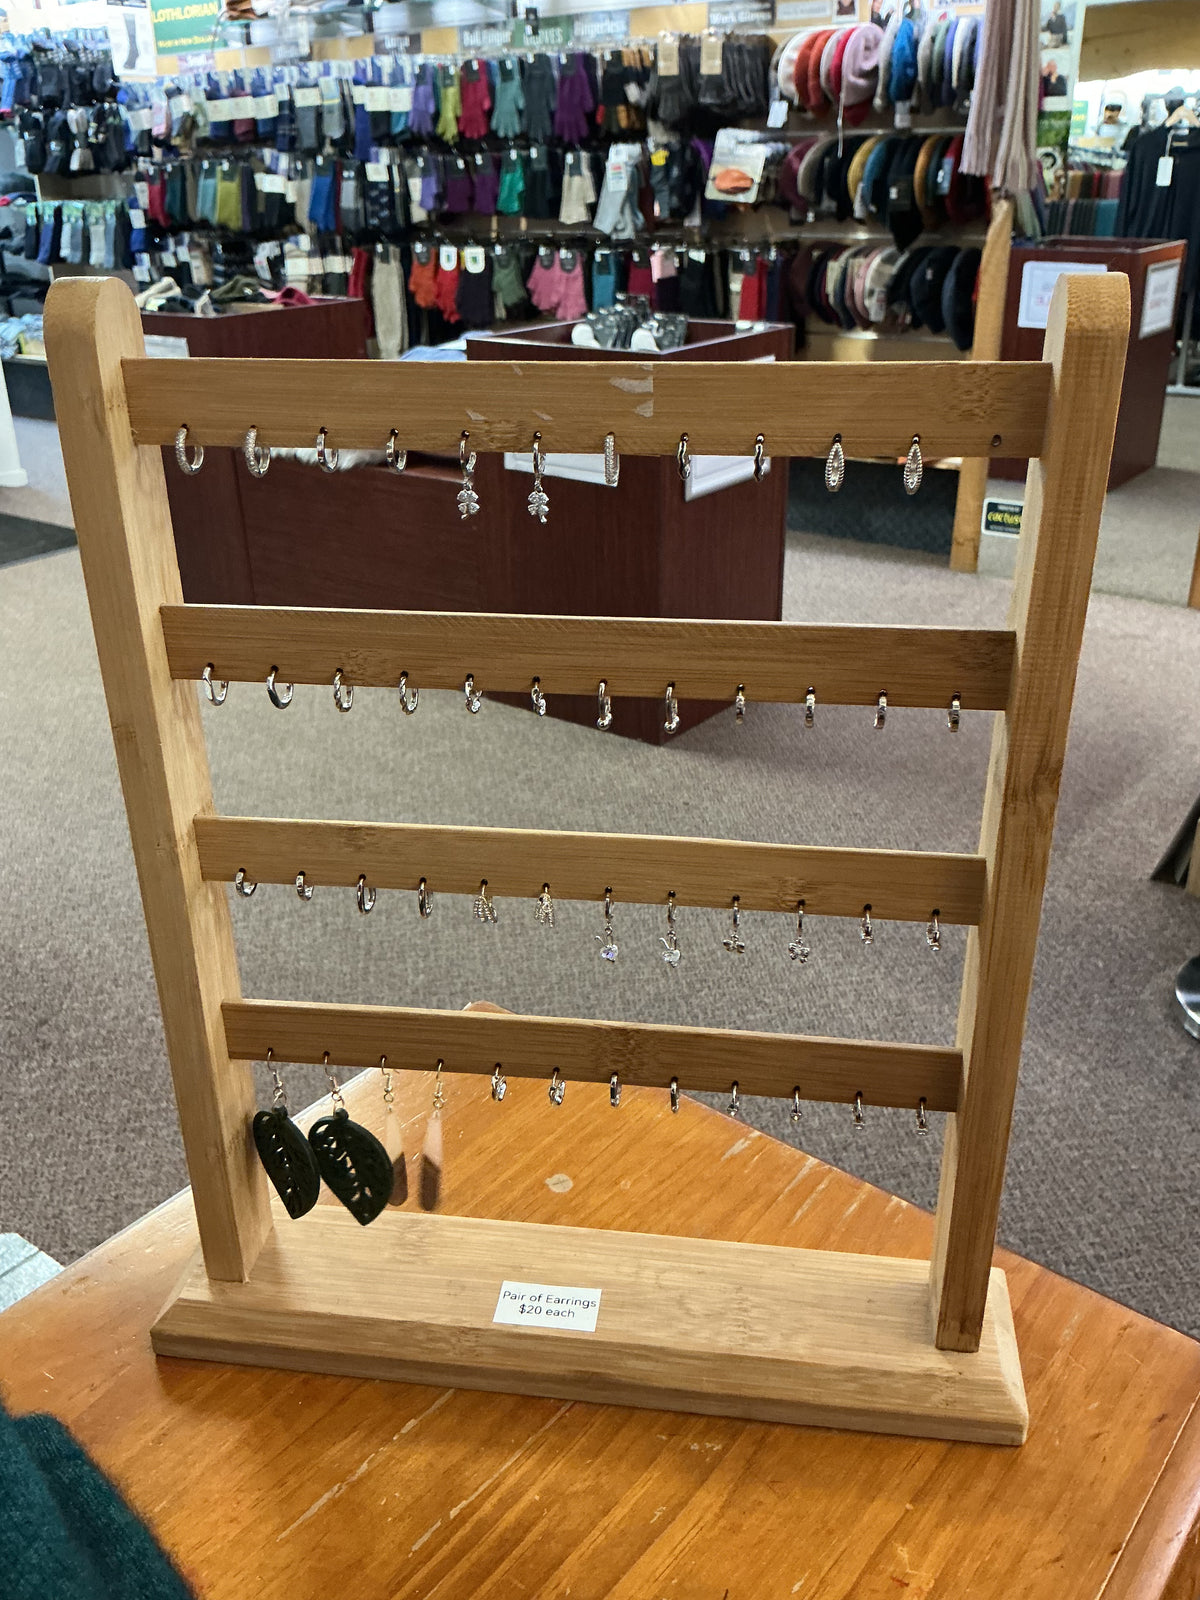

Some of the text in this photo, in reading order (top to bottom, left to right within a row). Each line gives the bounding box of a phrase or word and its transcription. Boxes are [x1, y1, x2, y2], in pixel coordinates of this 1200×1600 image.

[152, 2, 218, 23] LOTHLORIAN
[503, 1290, 597, 1309] Pair of Earrings
[518, 1303, 575, 1318] $20 each
